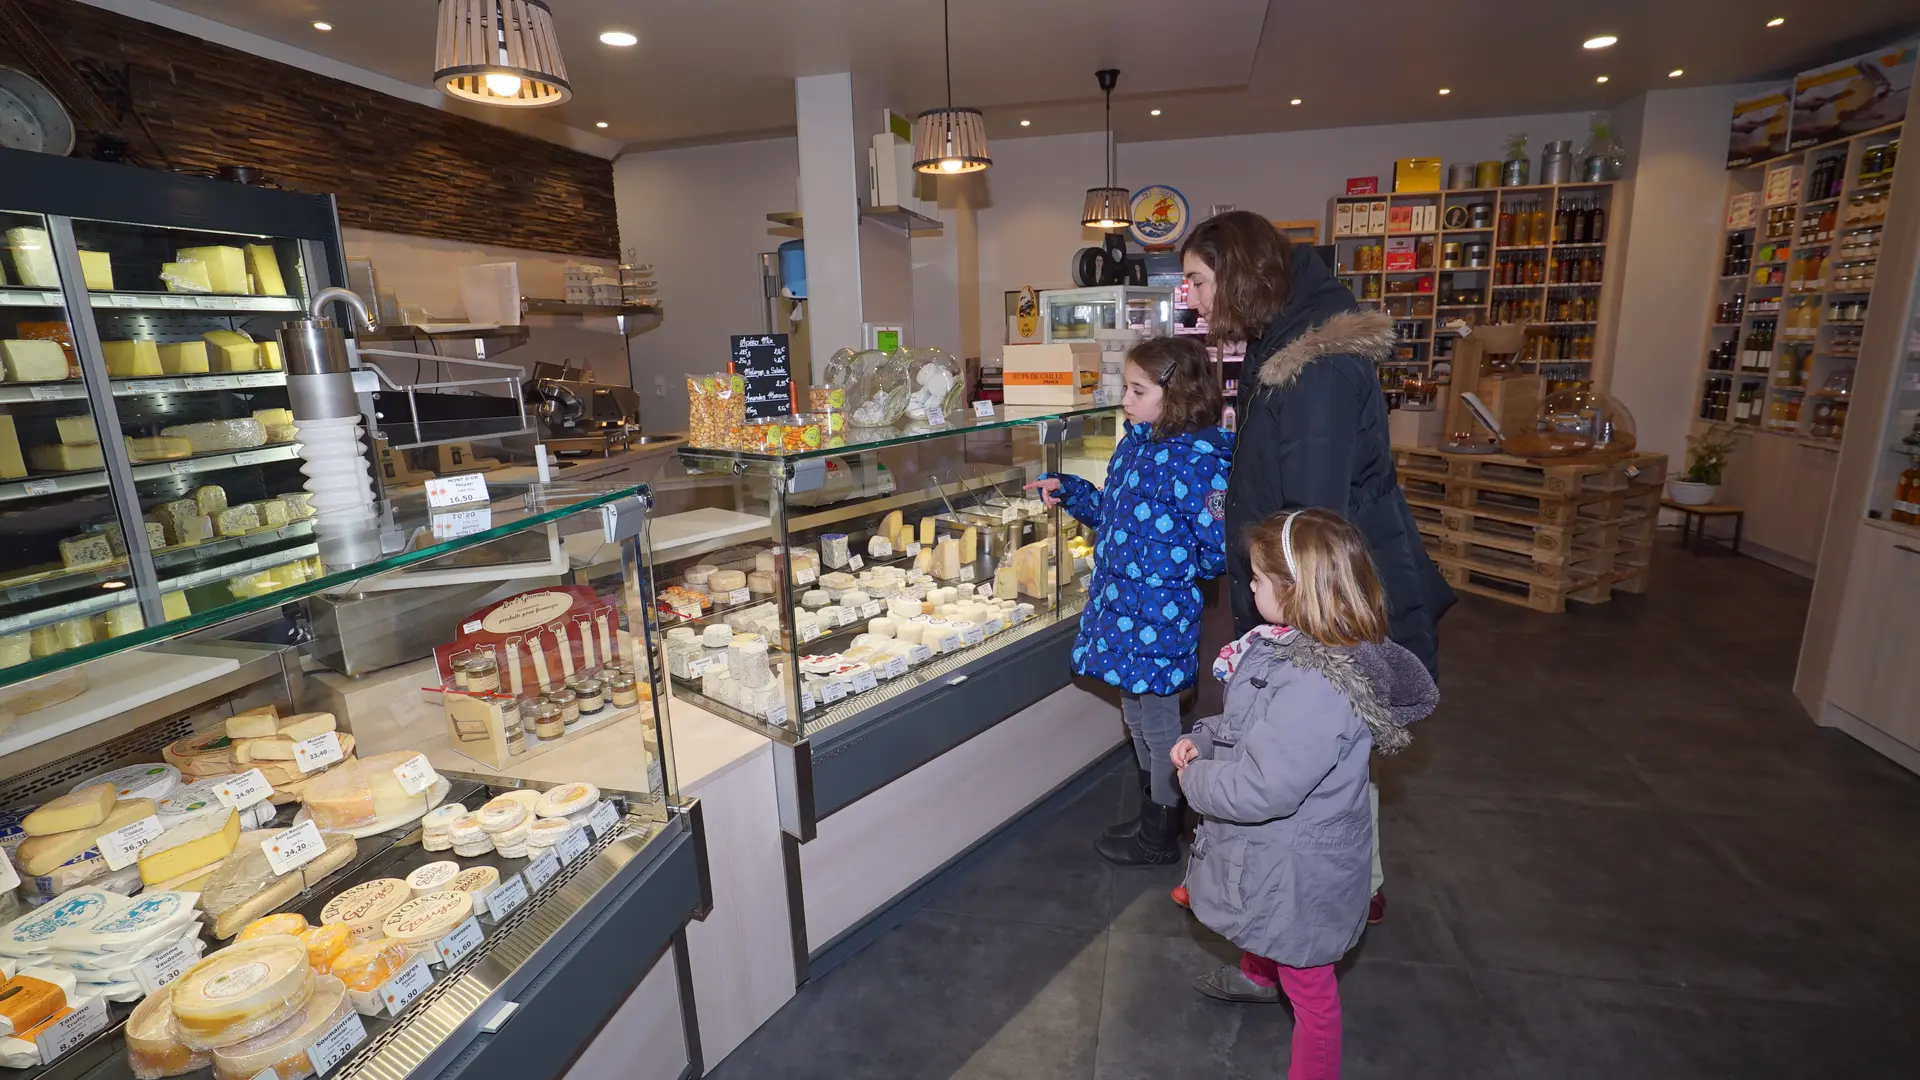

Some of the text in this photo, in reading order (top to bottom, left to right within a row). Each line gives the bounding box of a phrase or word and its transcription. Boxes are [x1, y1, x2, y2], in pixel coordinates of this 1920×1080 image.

[450, 495, 473, 503] 16,50
[310, 750, 328, 759] 23,40
[225, 771, 254, 786] Reblochon
[235, 787, 255, 799] 24,90
[275, 822, 309, 841] Saint Nectaire
[123, 838, 149, 853] 36,30
[285, 843, 307, 857] 24,20
[502, 901, 516, 914] 3,90
[155, 946, 178, 962] Tomme
[452, 941, 472, 959] 11,60
[155, 950, 184, 969] Vaudoise
[158, 969, 180, 986] 6,30
[395, 964, 418, 985] Langres
[400, 989, 418, 1006] 5,90
[59, 1005, 90, 1027] Tomme
[316, 1012, 357, 1048] Soumaintrain
[59, 1032, 85, 1052] 8,95
[327, 1043, 351, 1067] 12,20
